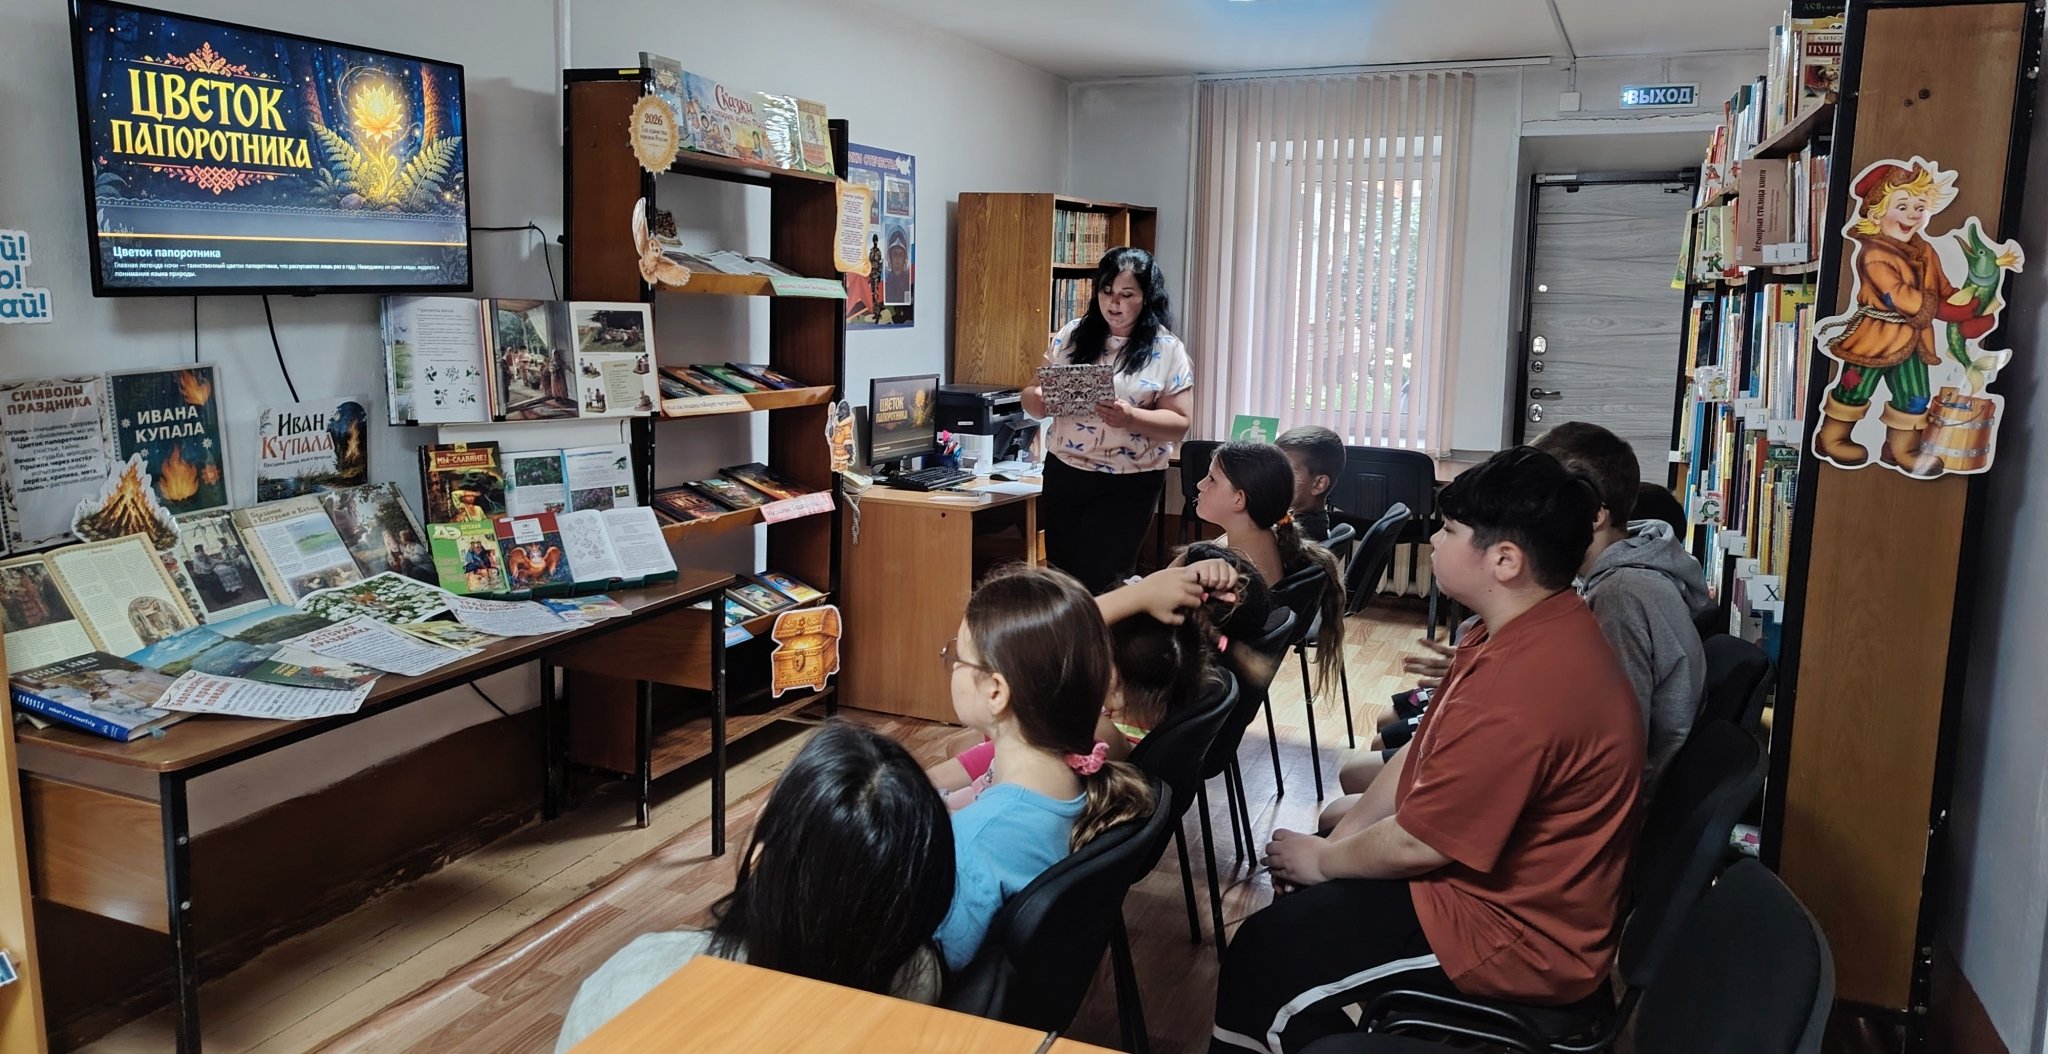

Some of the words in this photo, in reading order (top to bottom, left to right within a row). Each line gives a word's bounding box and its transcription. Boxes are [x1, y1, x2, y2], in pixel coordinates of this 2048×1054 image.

[128, 68, 287, 131] ЦВЕТОК
[1628, 88, 1691, 105] ВЫХОД
[644, 112, 662, 126] 2026
[110, 119, 313, 169] ПАПОРОТНИКА
[113, 246, 153, 258] Цветок
[155, 248, 221, 260] папоротника
[114, 261, 138, 269] Главная
[139, 262, 163, 270] легенда
[169, 271, 197, 279] природы.
[11, 385, 84, 402] СИМВОЛЫ
[7, 396, 92, 416] ПРАЗДНИКА
[879, 397, 905, 413] ЦВЕТОК
[137, 405, 199, 425] ИВАНА
[135, 422, 205, 444] КУПАЛА
[278, 412, 324, 437] Иван
[17, 441, 43, 449] Цветок
[44, 435, 88, 446] папоротника
[261, 431, 334, 460] Купала
[20, 463, 48, 471] Прыжок
[17, 485, 44, 493] полынь
